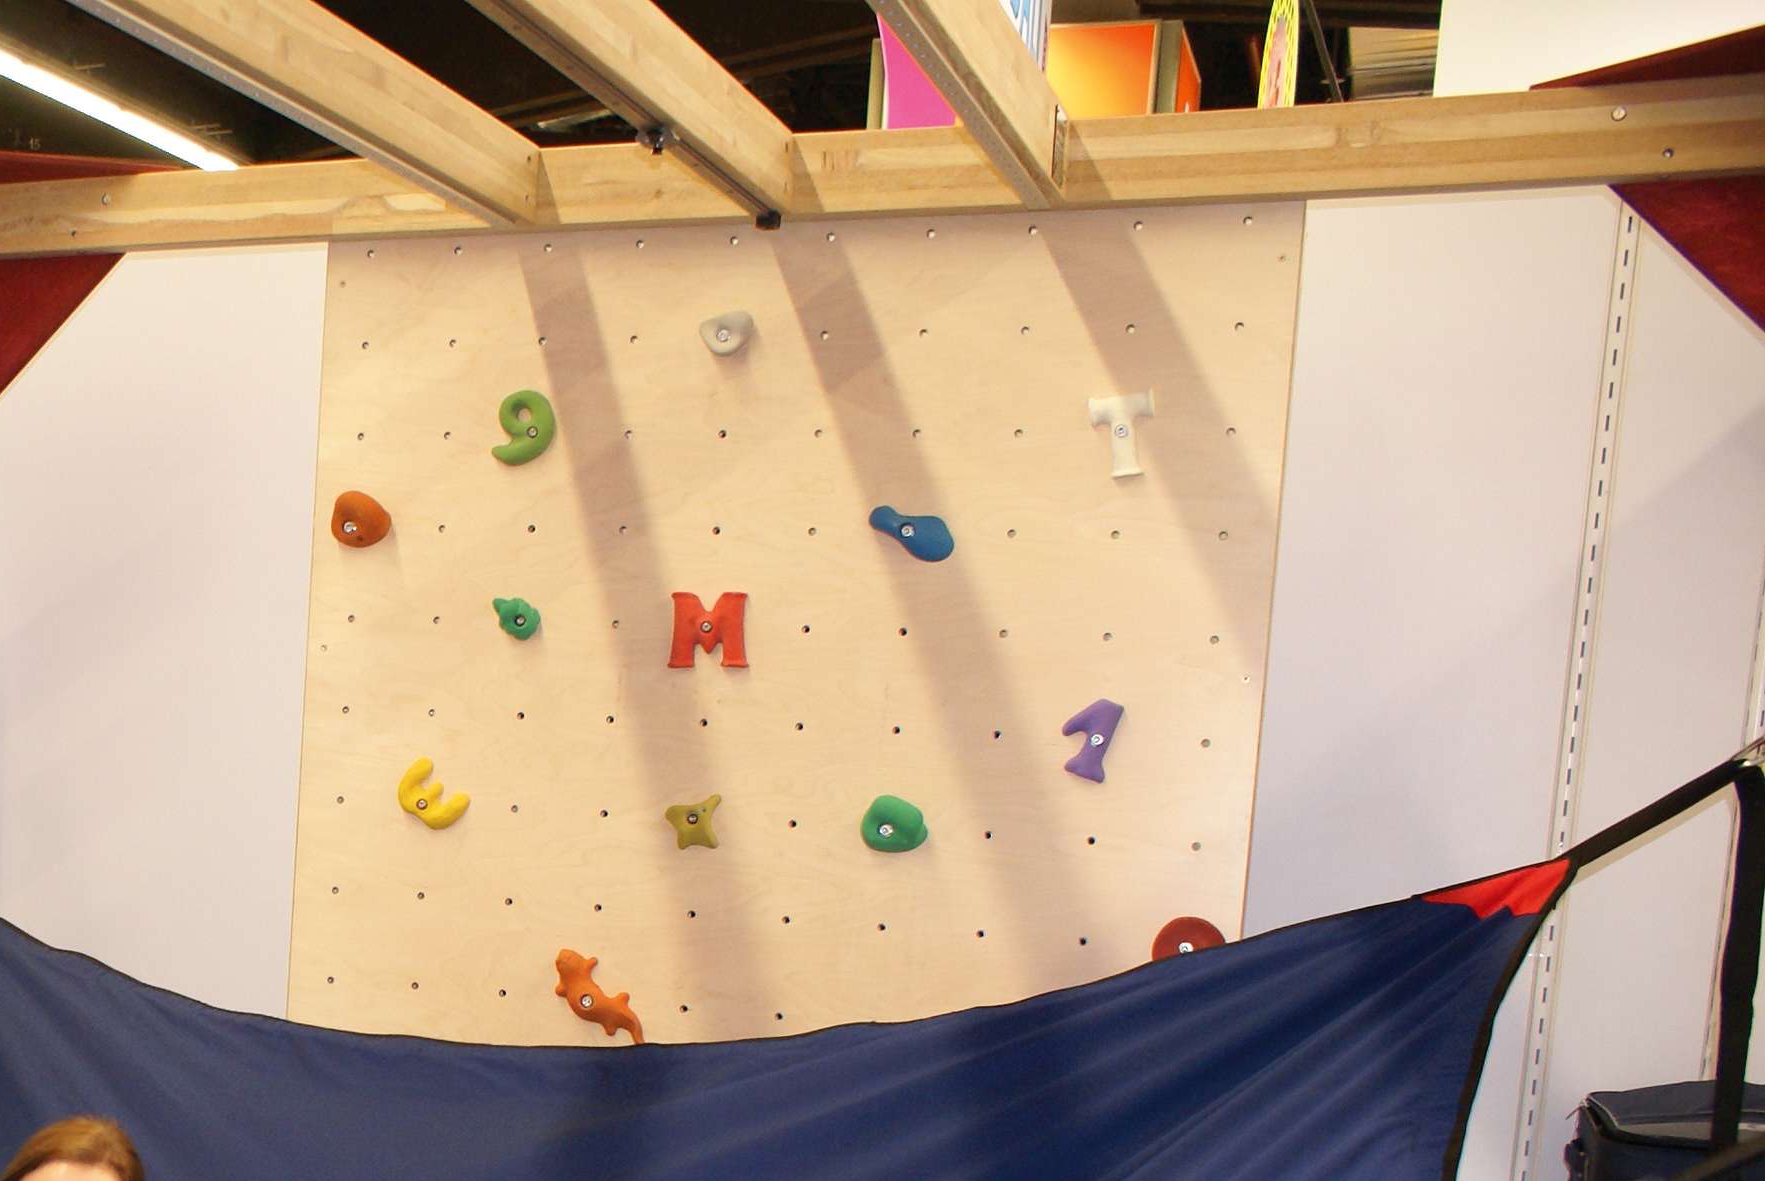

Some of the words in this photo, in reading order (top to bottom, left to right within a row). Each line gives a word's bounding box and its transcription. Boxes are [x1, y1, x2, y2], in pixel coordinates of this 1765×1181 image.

[492, 390, 555, 465] 9
[1088, 387, 1155, 479] T
[667, 591, 749, 669] M
[1062, 698, 1125, 783] 1
